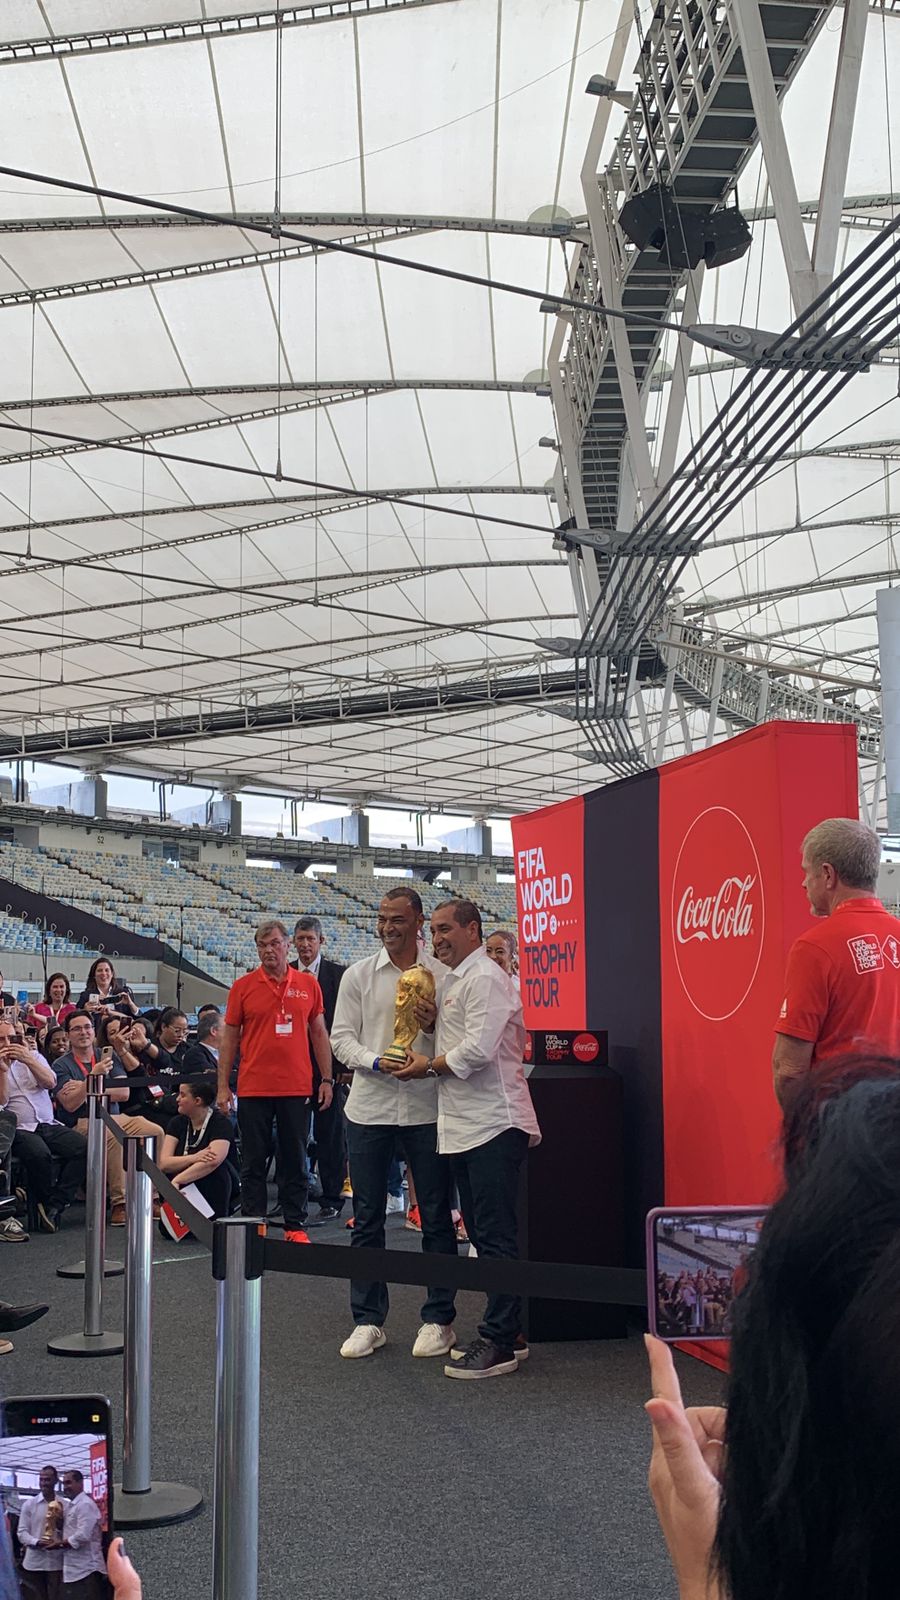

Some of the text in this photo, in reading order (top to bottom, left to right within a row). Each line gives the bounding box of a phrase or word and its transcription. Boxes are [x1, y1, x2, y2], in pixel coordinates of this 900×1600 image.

[518, 847, 546, 880] FIFA
[520, 873, 573, 911] WORLD
[677, 873, 757, 944] Coca-Cola
[522, 911, 549, 944] CUP
[524, 941, 577, 975] TROPHY
[851, 939, 867, 951] FIFA
[855, 943, 877, 955] WORLD
[859, 960, 877, 970] TOUR
[525, 978, 560, 1008] TOUR
